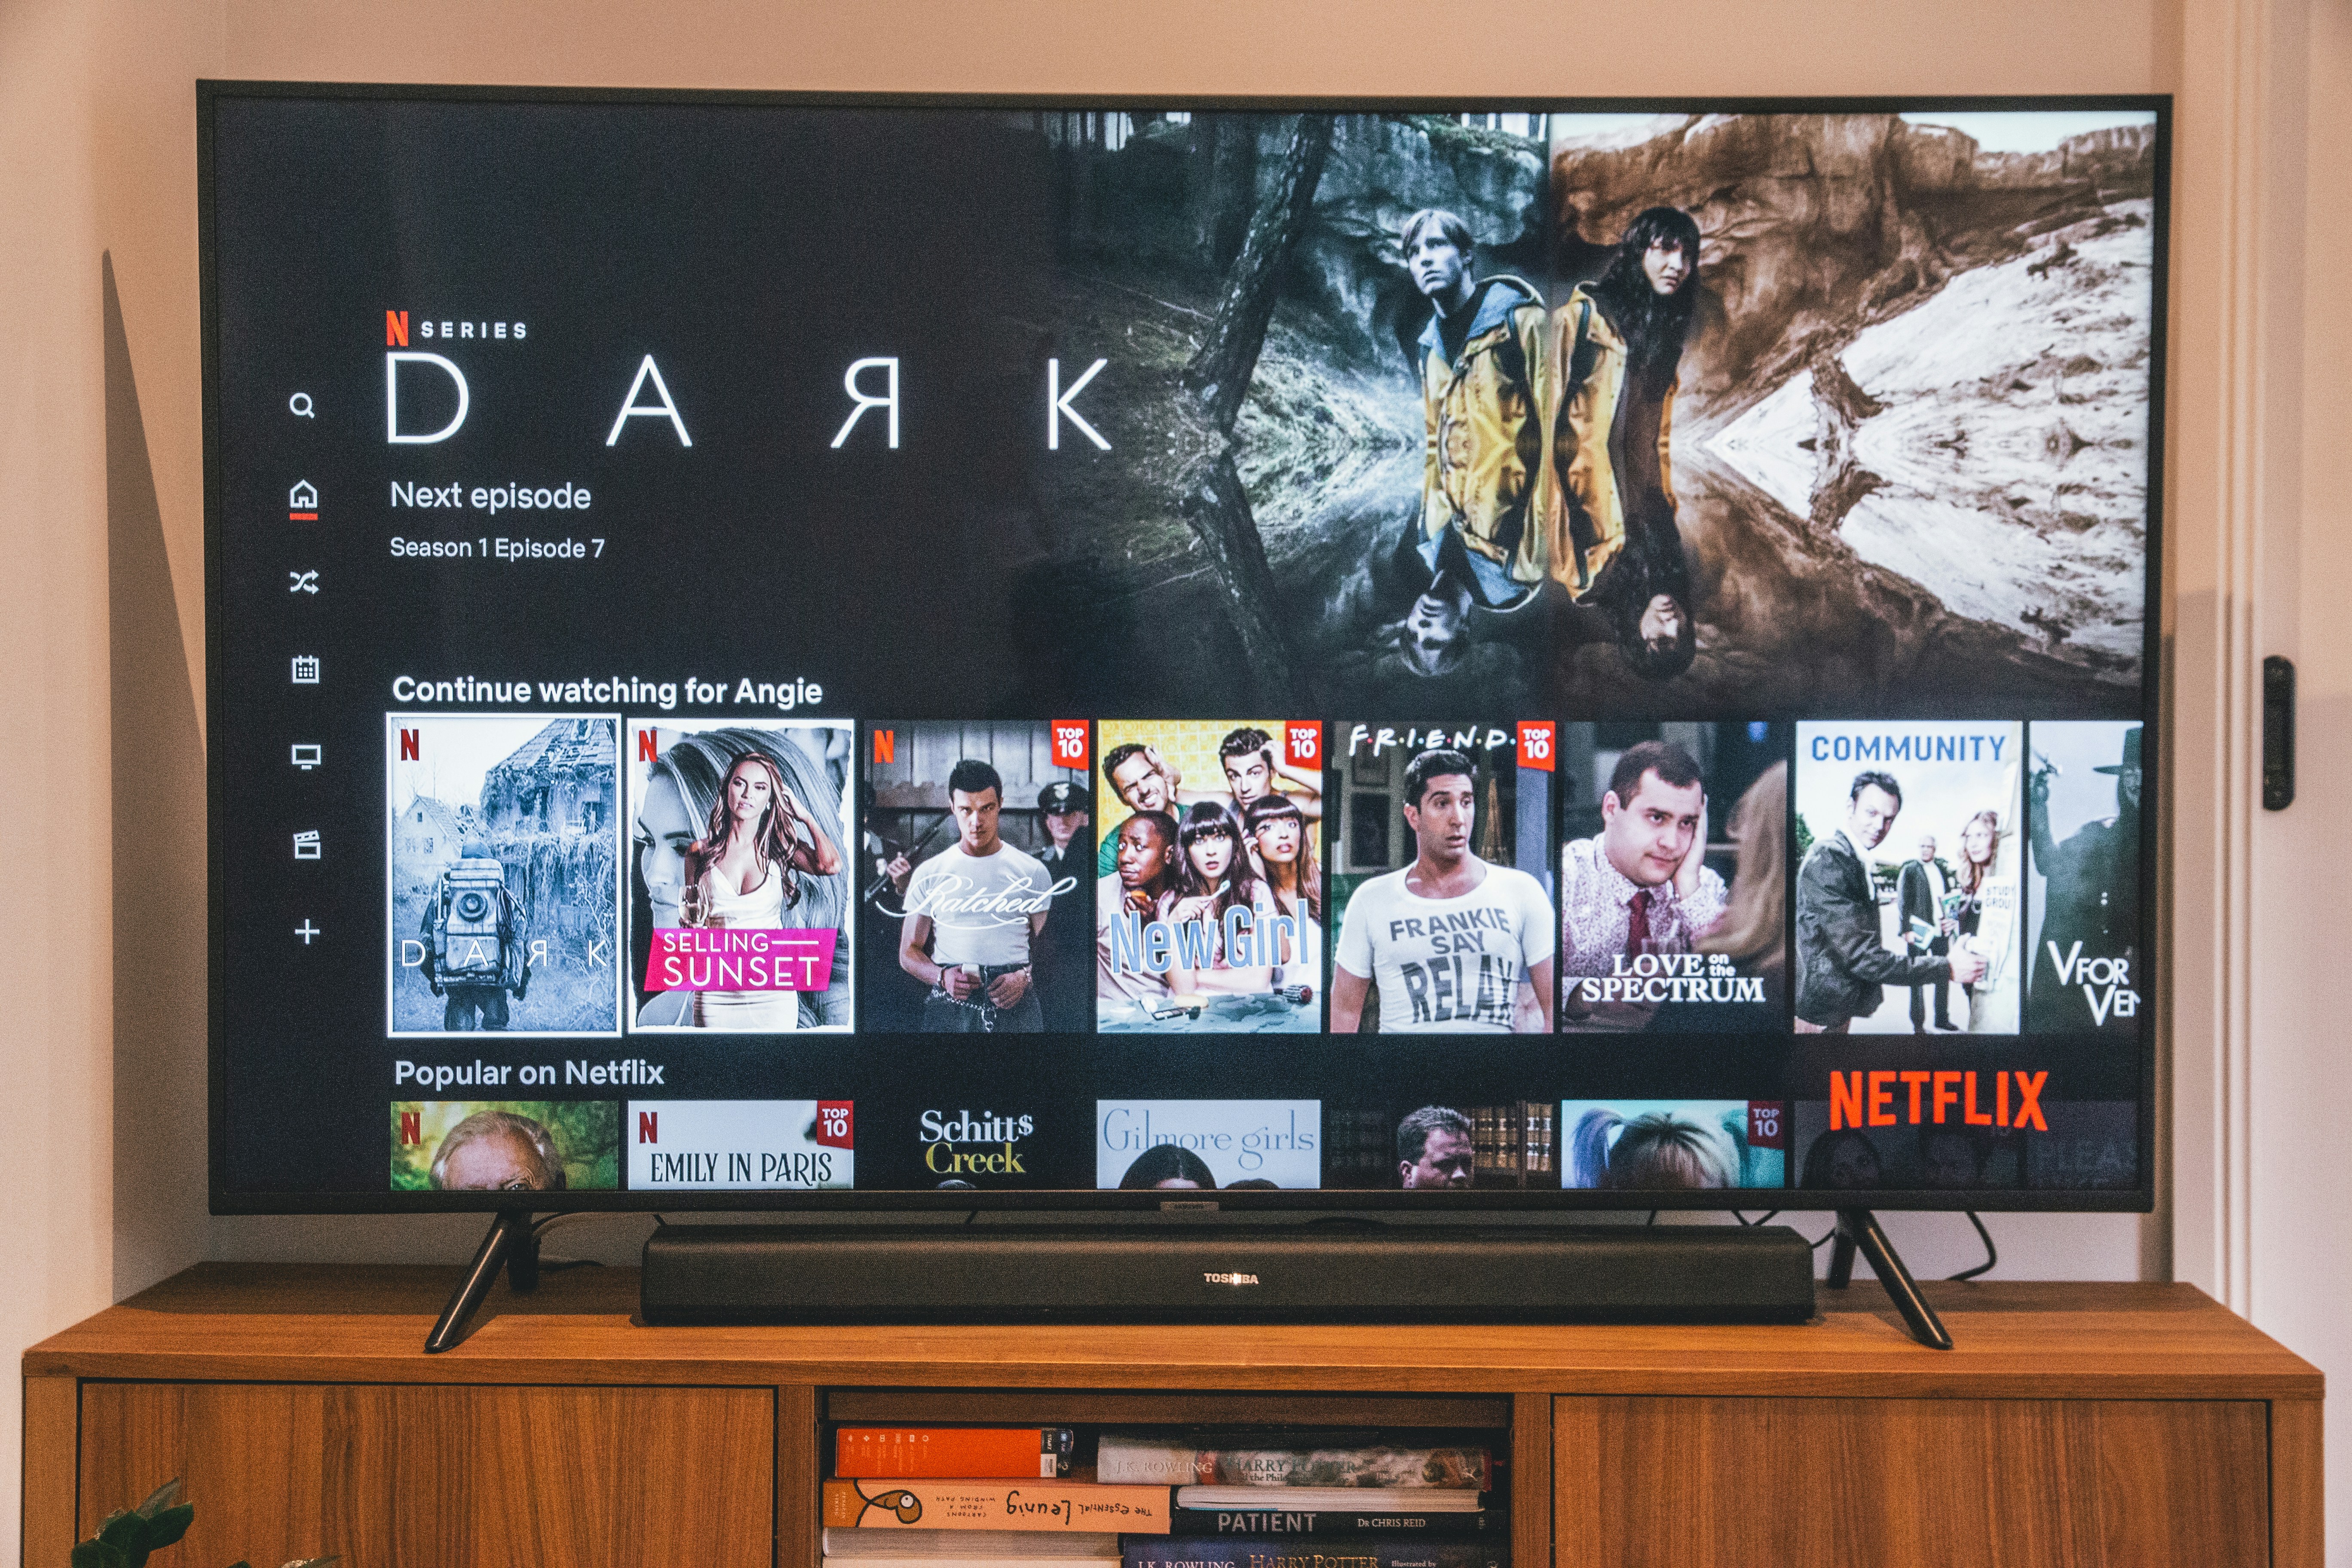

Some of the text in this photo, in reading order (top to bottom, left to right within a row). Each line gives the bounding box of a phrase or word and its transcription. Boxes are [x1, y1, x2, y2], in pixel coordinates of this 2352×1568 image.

[387, 310, 527, 346] N SERIES
[391, 481, 591, 515] Next episode
[390, 537, 605, 562] Season 1 Episode 7
[392, 676, 823, 710] Continue watching for Angie
[400, 729, 420, 761] N
[639, 729, 657, 763] N
[1057, 728, 1085, 738] TOP
[1290, 728, 1317, 740] TOP
[1522, 729, 1551, 738] TOP
[874, 730, 894, 763] N
[1058, 739, 1084, 758] 10
[1291, 739, 1316, 758] 10
[1524, 739, 1549, 759] 10
[1812, 735, 2006, 761] COMMUNITY
[876, 873, 1077, 930] Ratched
[1109, 898, 1309, 975] New Girl
[1389, 907, 1511, 942] FRANKIE
[663, 932, 769, 952] SELLING
[1430, 931, 1486, 955] SAY
[663, 957, 820, 986] SUNSET
[1612, 953, 1736, 977] LOVE on the
[2046, 940, 2130, 986] V FOR
[1581, 977, 1766, 1003] SPECTRUM
[395, 1059, 665, 1092] Popular on Netflix
[822, 1108, 849, 1119] TOP
[1753, 1108, 1780, 1118] TOP
[1830, 1071, 2049, 1131] NETFLIX
[401, 1112, 421, 1145] N
[639, 1112, 658, 1144] N
[823, 1118, 848, 1137] 10
[1103, 1108, 1314, 1171] Gilmore girls
[1754, 1118, 1779, 1137] 10
[651, 1152, 833, 1186] EMILY IN PARIS
[925, 1142, 1027, 1173] Creek
[1204, 1272, 1259, 1285] TOSHIBA
[1144, 1461, 1213, 1474] ROWLING
[1006, 1490, 1071, 1525] Leunig
[1218, 1513, 1317, 1532] PATIENT
[1372, 1519, 1402, 1527] CHRIS
[1403, 1518, 1426, 1527] REID
[1249, 1555, 1378, 1568] HARRY POTTER
